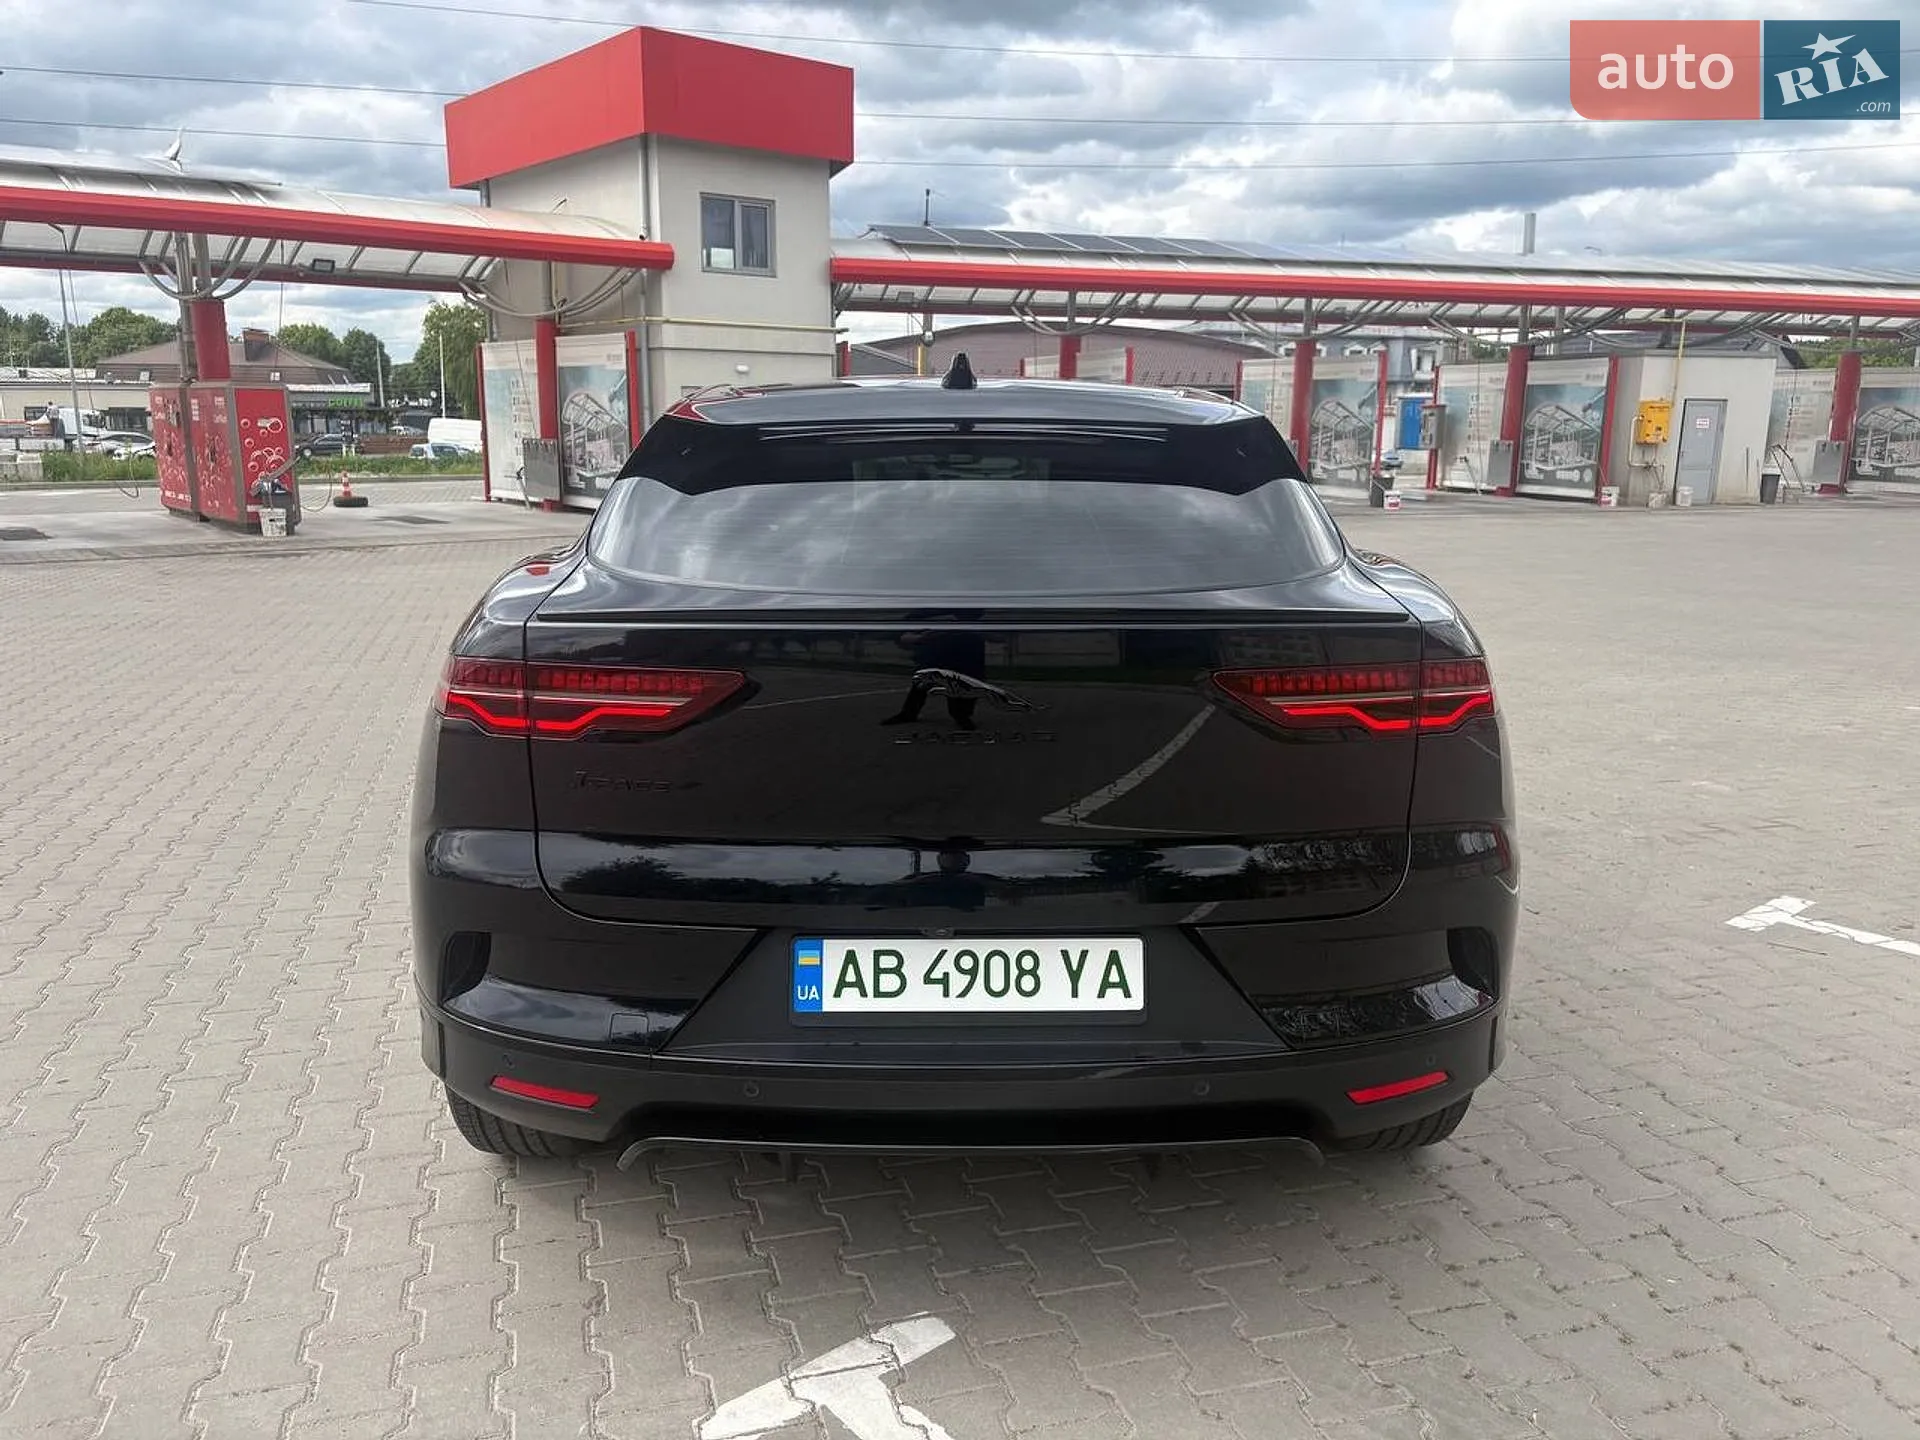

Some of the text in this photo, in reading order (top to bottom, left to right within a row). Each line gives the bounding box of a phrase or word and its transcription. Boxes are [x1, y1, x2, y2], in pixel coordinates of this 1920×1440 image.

[833, 949, 1133, 999] AB 4908 YA
[797, 985, 820, 1001] UA
